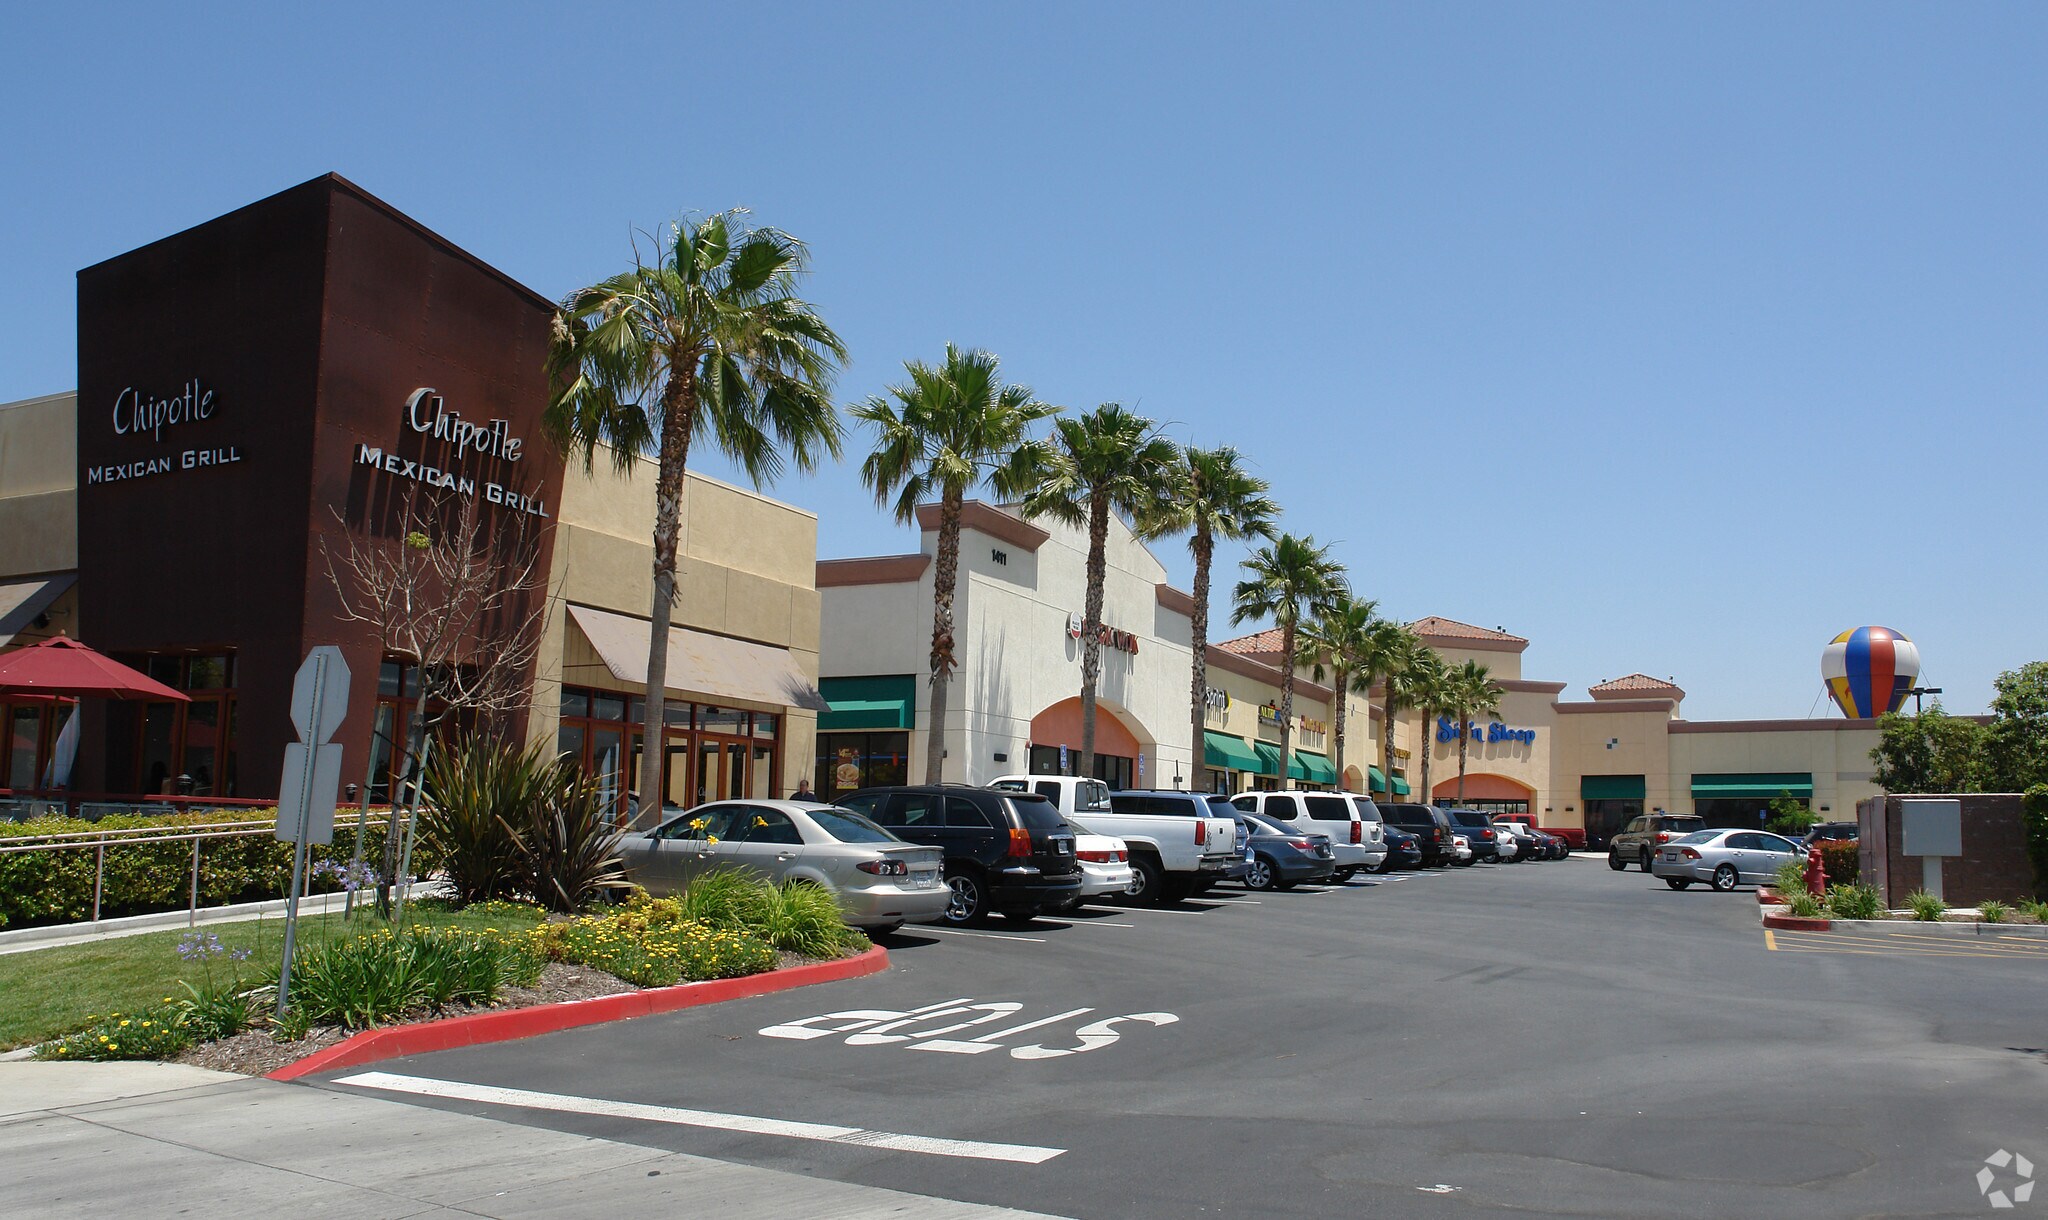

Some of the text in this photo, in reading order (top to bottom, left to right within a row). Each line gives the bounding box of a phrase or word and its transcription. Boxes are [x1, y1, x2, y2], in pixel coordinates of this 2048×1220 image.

[112, 378, 215, 442] Chipotle
[404, 386, 523, 463] Chipotle
[87, 445, 242, 485] MEXICAN GRILL
[358, 443, 550, 519] MEXICAN GRILL
[1437, 715, 1462, 743] Si
[1488, 722, 1536, 745] Sleep
[758, 997, 1180, 1060] STOP
